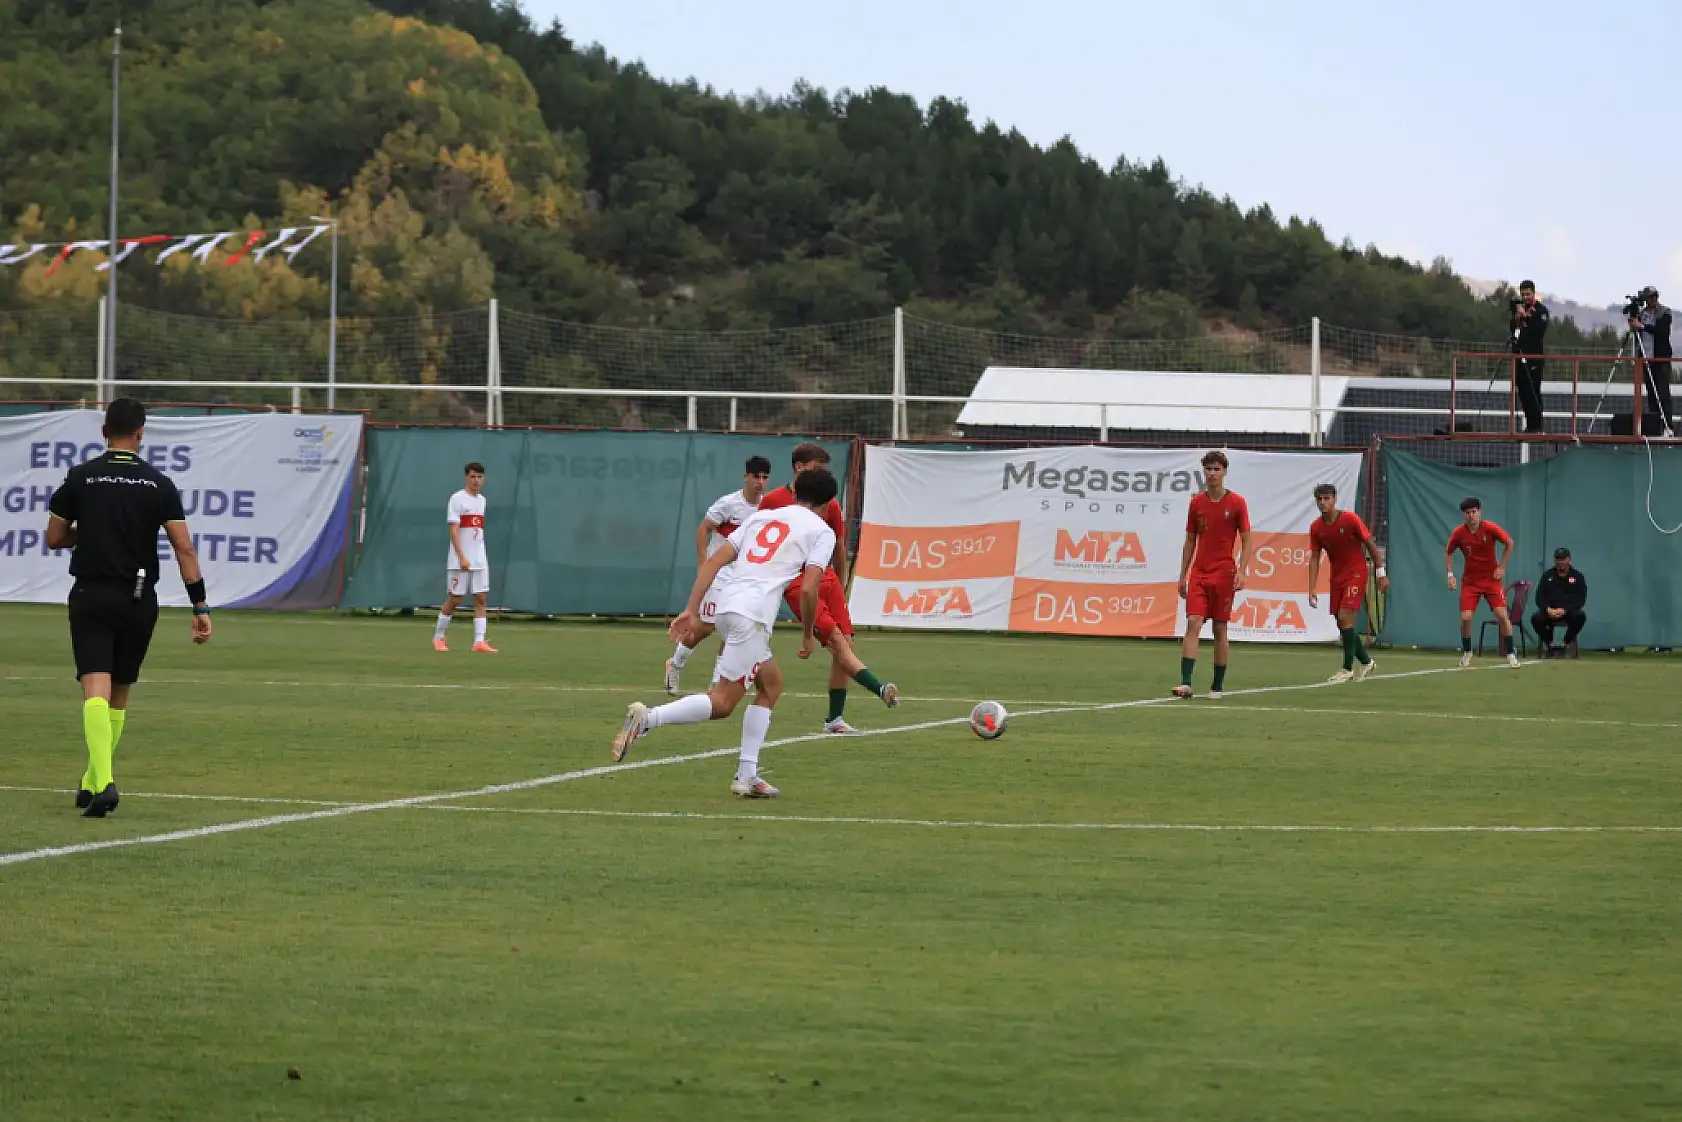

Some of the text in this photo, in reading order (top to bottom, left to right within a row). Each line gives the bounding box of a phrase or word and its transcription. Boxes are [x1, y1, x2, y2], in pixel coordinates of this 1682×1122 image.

[30, 441, 192, 472] ERCES
[1040, 500, 1171, 515] SPORTS
[746, 520, 791, 565] 9
[880, 535, 997, 569] DAS 3917
[1054, 528, 1148, 563] MTA
[703, 601, 716, 618] 10
[882, 586, 974, 615] MTA
[1034, 592, 1157, 625] DAS 3917
